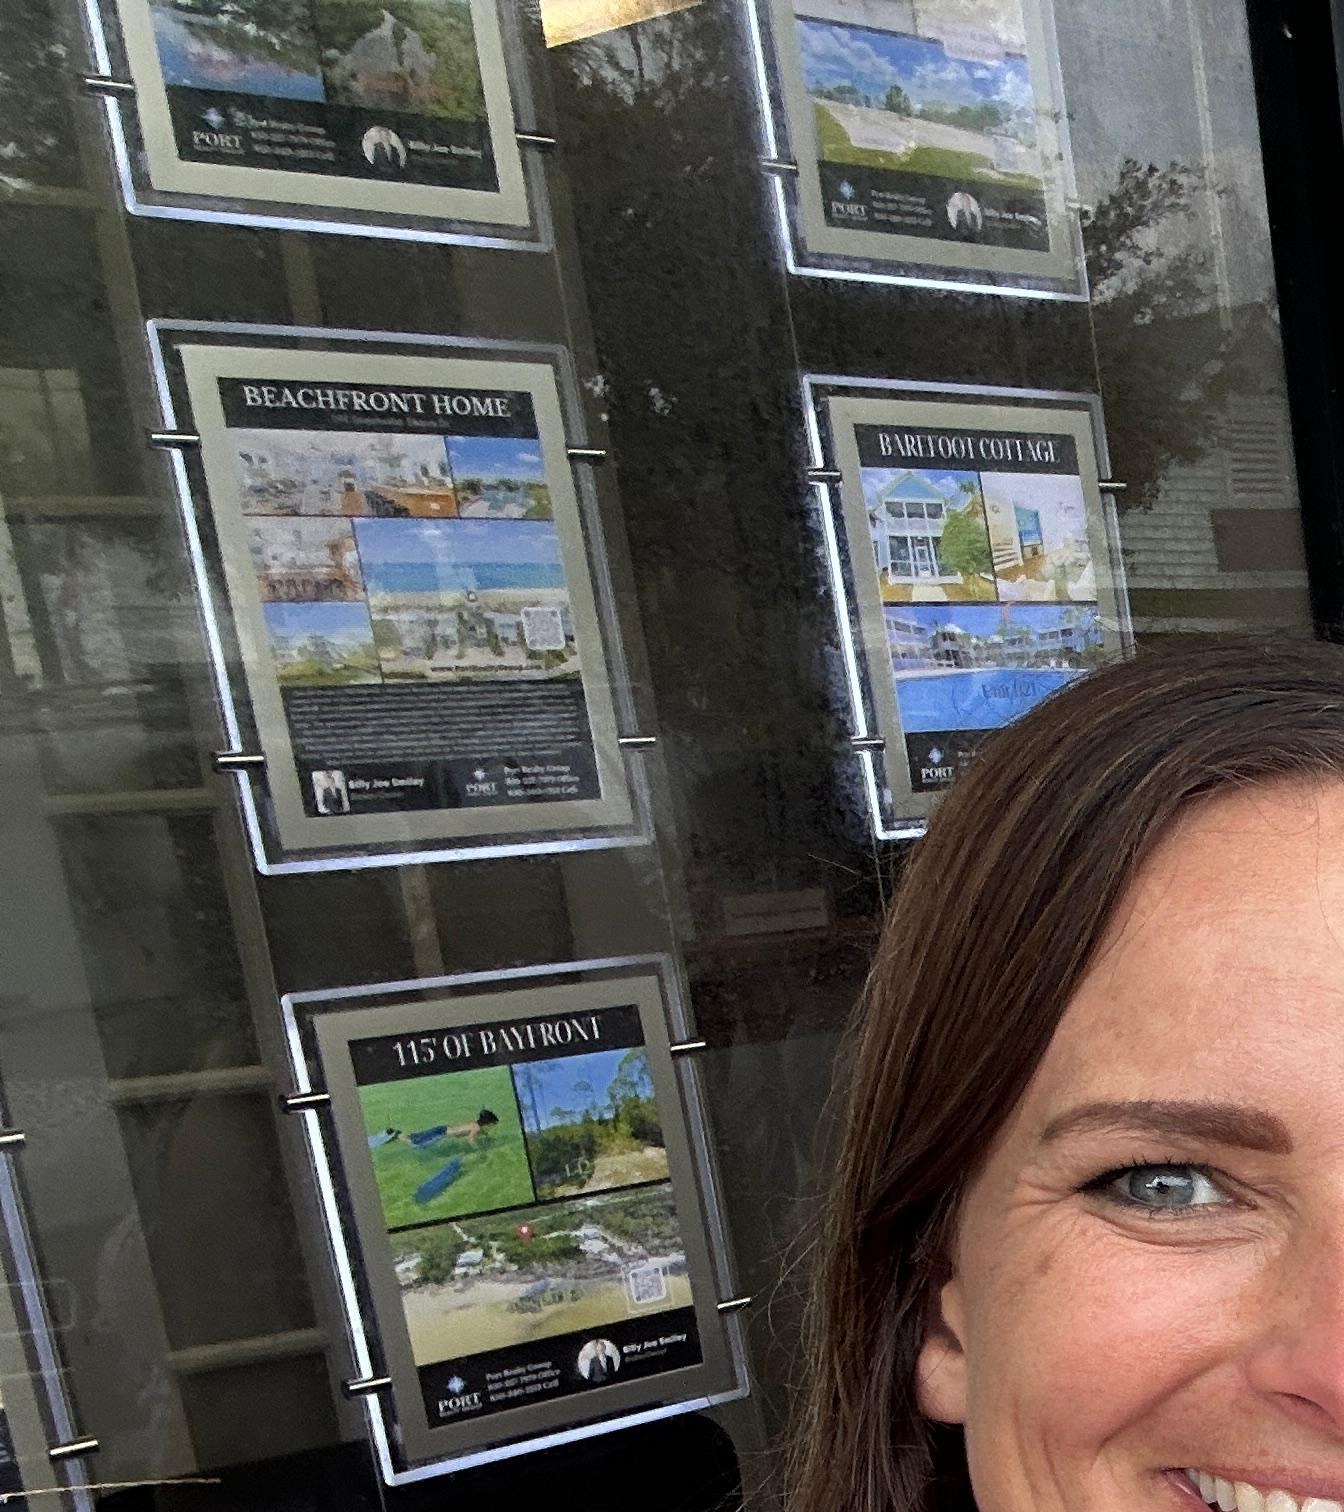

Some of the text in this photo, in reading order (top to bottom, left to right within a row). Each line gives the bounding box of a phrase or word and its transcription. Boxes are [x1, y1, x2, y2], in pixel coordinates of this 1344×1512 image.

[242, 385, 512, 418] BEACHFRONT HOME
[878, 432, 1061, 463] BAREFOOT COTTAGE
[920, 766, 954, 779] PORT
[442, 1033, 473, 1060] OF
[478, 1016, 601, 1056] BAYFRONT
[437, 1391, 482, 1413] PORT
